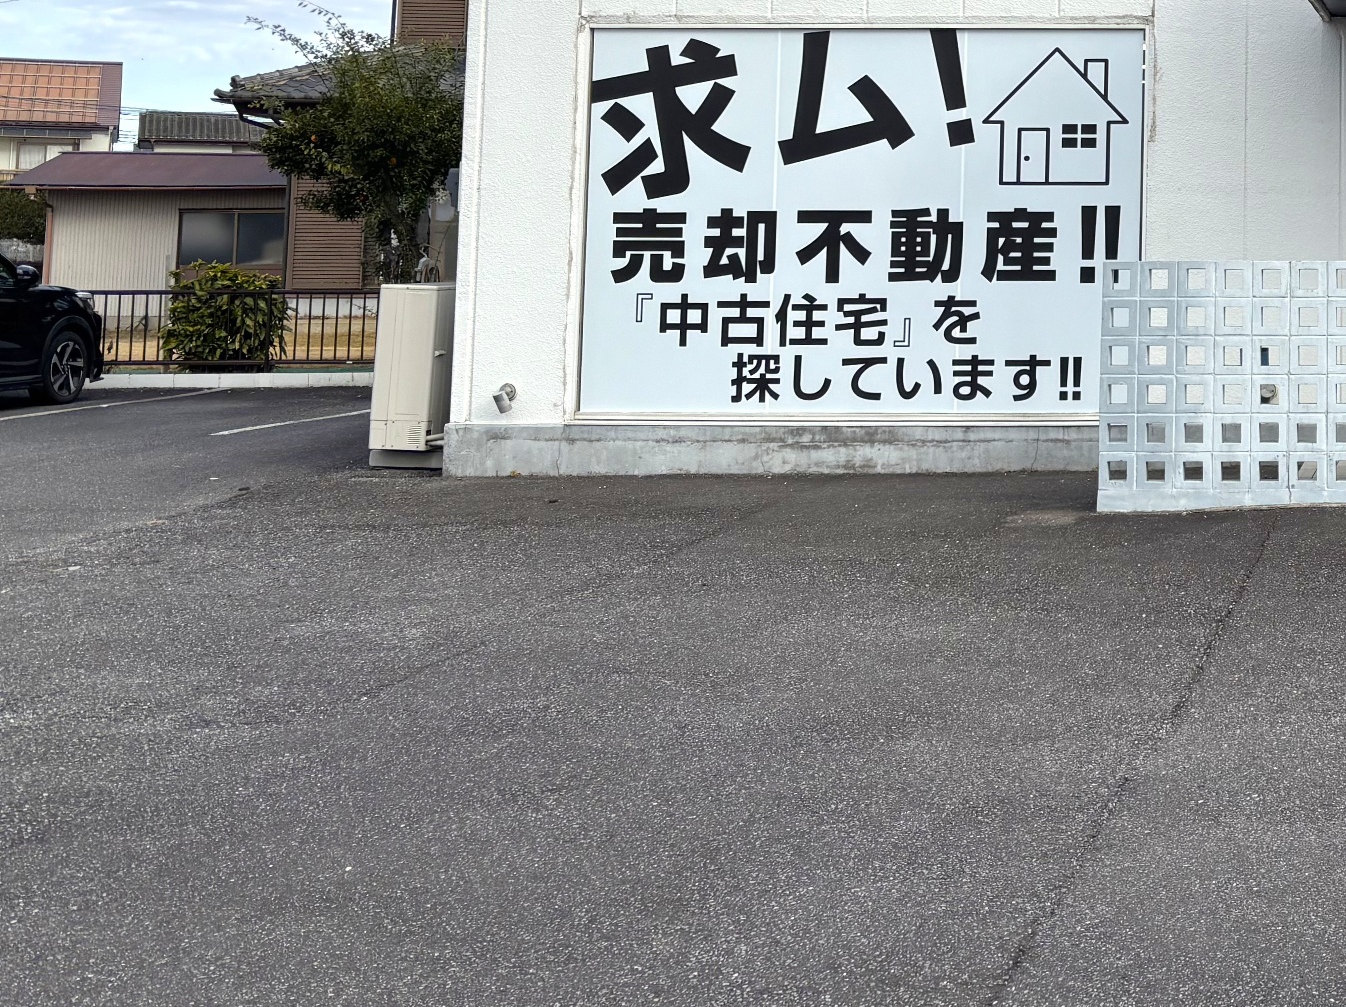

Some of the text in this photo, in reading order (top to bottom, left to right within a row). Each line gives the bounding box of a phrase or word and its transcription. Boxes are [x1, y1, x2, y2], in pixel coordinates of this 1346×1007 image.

[635, 293, 981, 348] 『中古住宅』を
